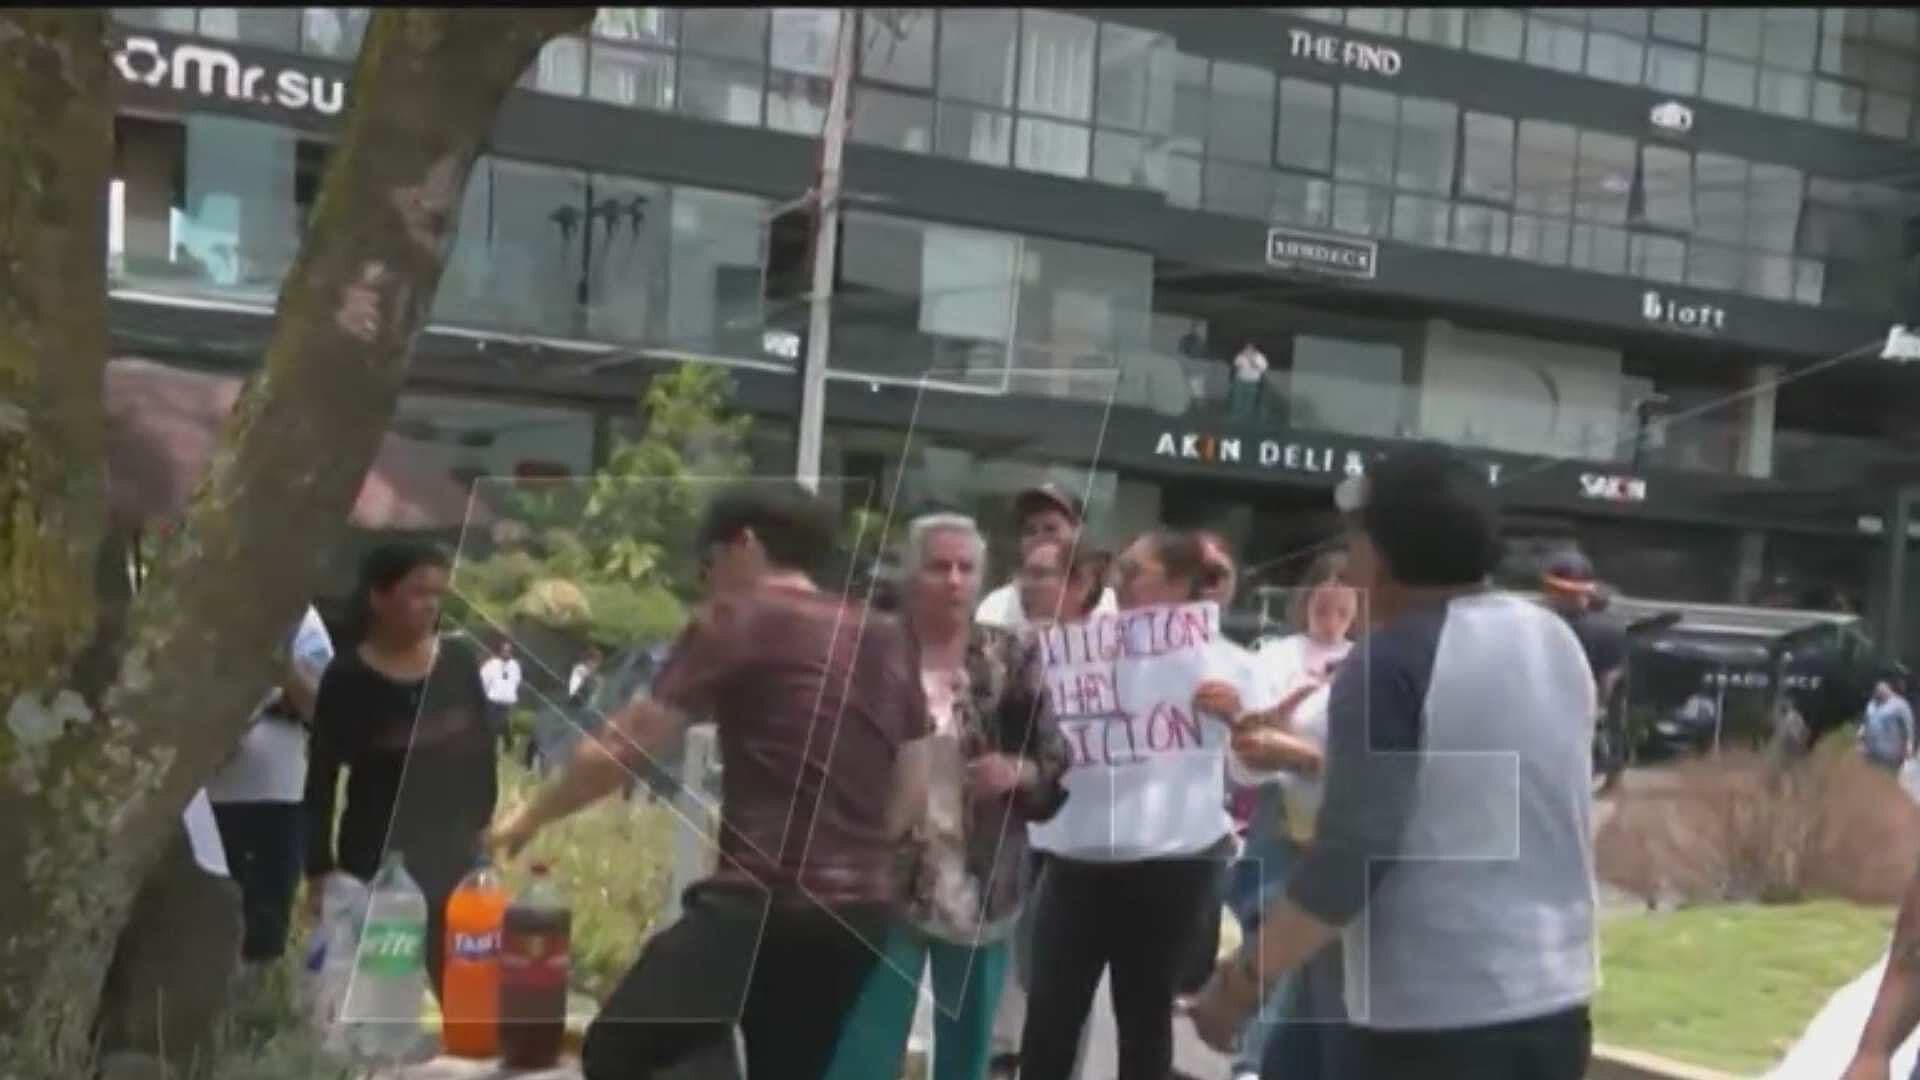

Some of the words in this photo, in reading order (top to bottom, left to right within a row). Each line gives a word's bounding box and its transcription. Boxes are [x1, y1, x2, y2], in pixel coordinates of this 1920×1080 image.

[1287, 29, 1339, 63] THE
[1154, 431, 1242, 462] AKIN
[1258, 439, 1334, 472] DELI
